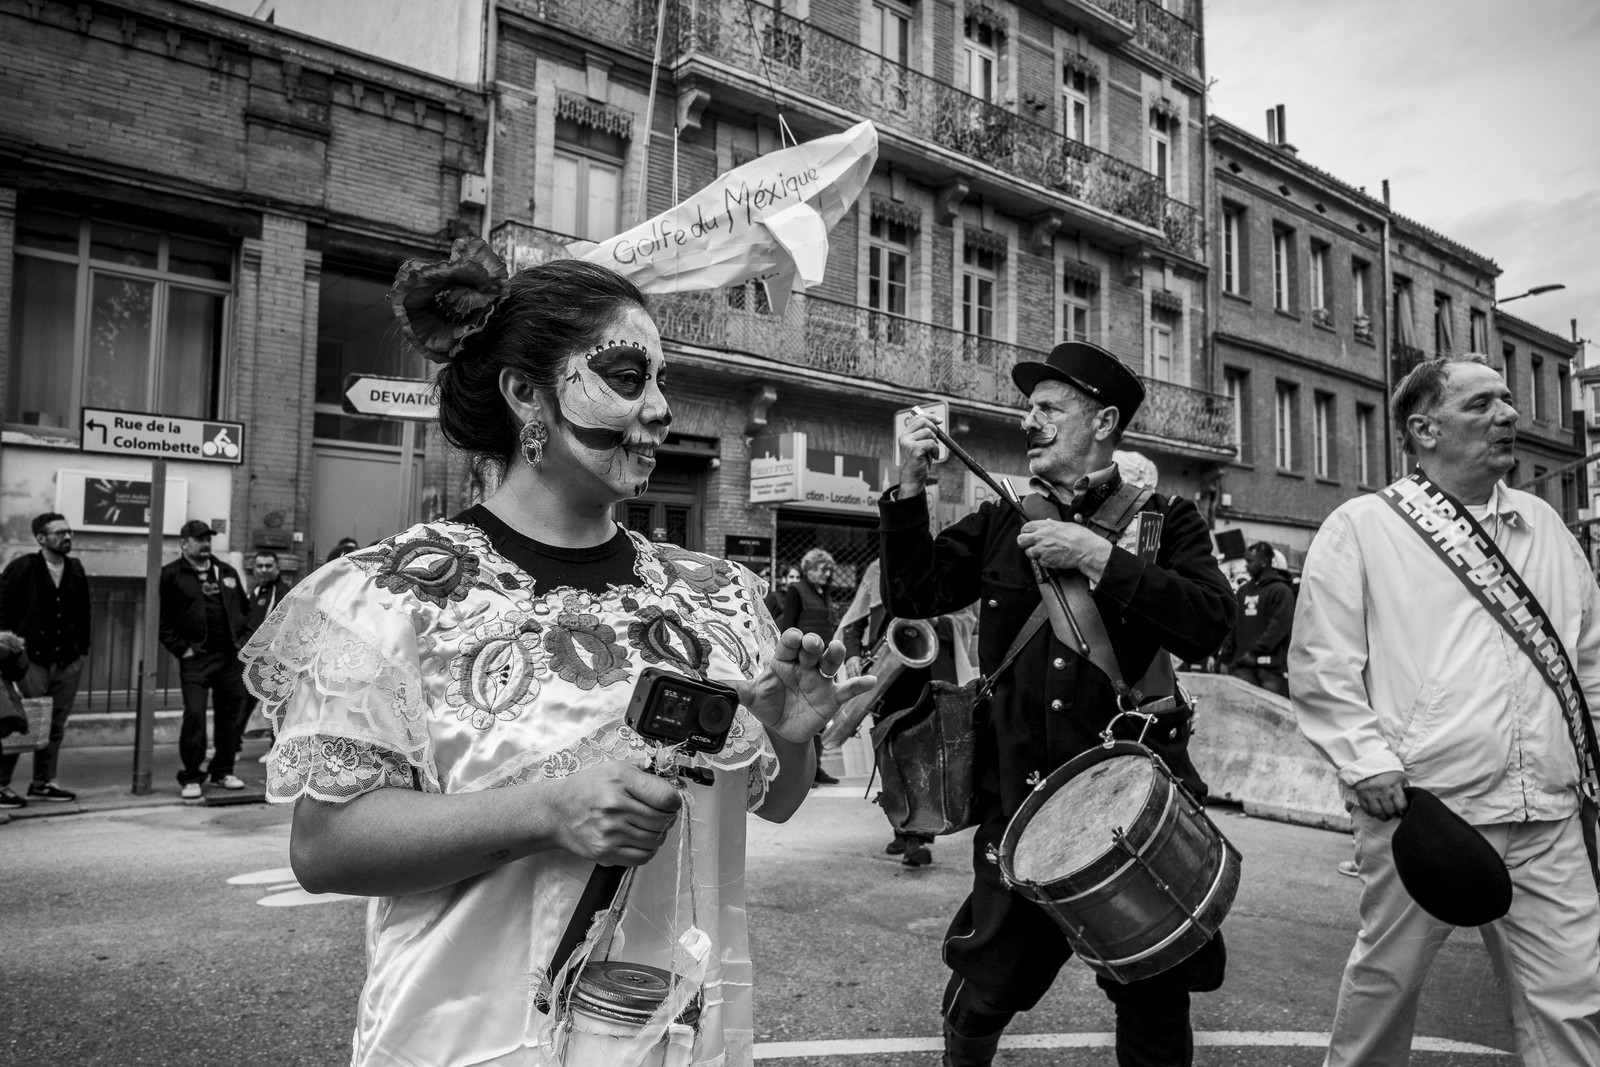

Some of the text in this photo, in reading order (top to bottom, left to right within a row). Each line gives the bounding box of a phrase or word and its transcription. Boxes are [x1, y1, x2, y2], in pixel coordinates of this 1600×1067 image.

[613, 168, 819, 266] Golfe du Méxique
[370, 389, 440, 406] DEVIATIO
[114, 416, 181, 434] Rue de la
[113, 436, 200, 454] Colombette
[830, 492, 861, 505] Location
[1397, 480, 1488, 567] LIBRE
[1465, 555, 1519, 604] DE
[1501, 596, 1545, 644] LA
